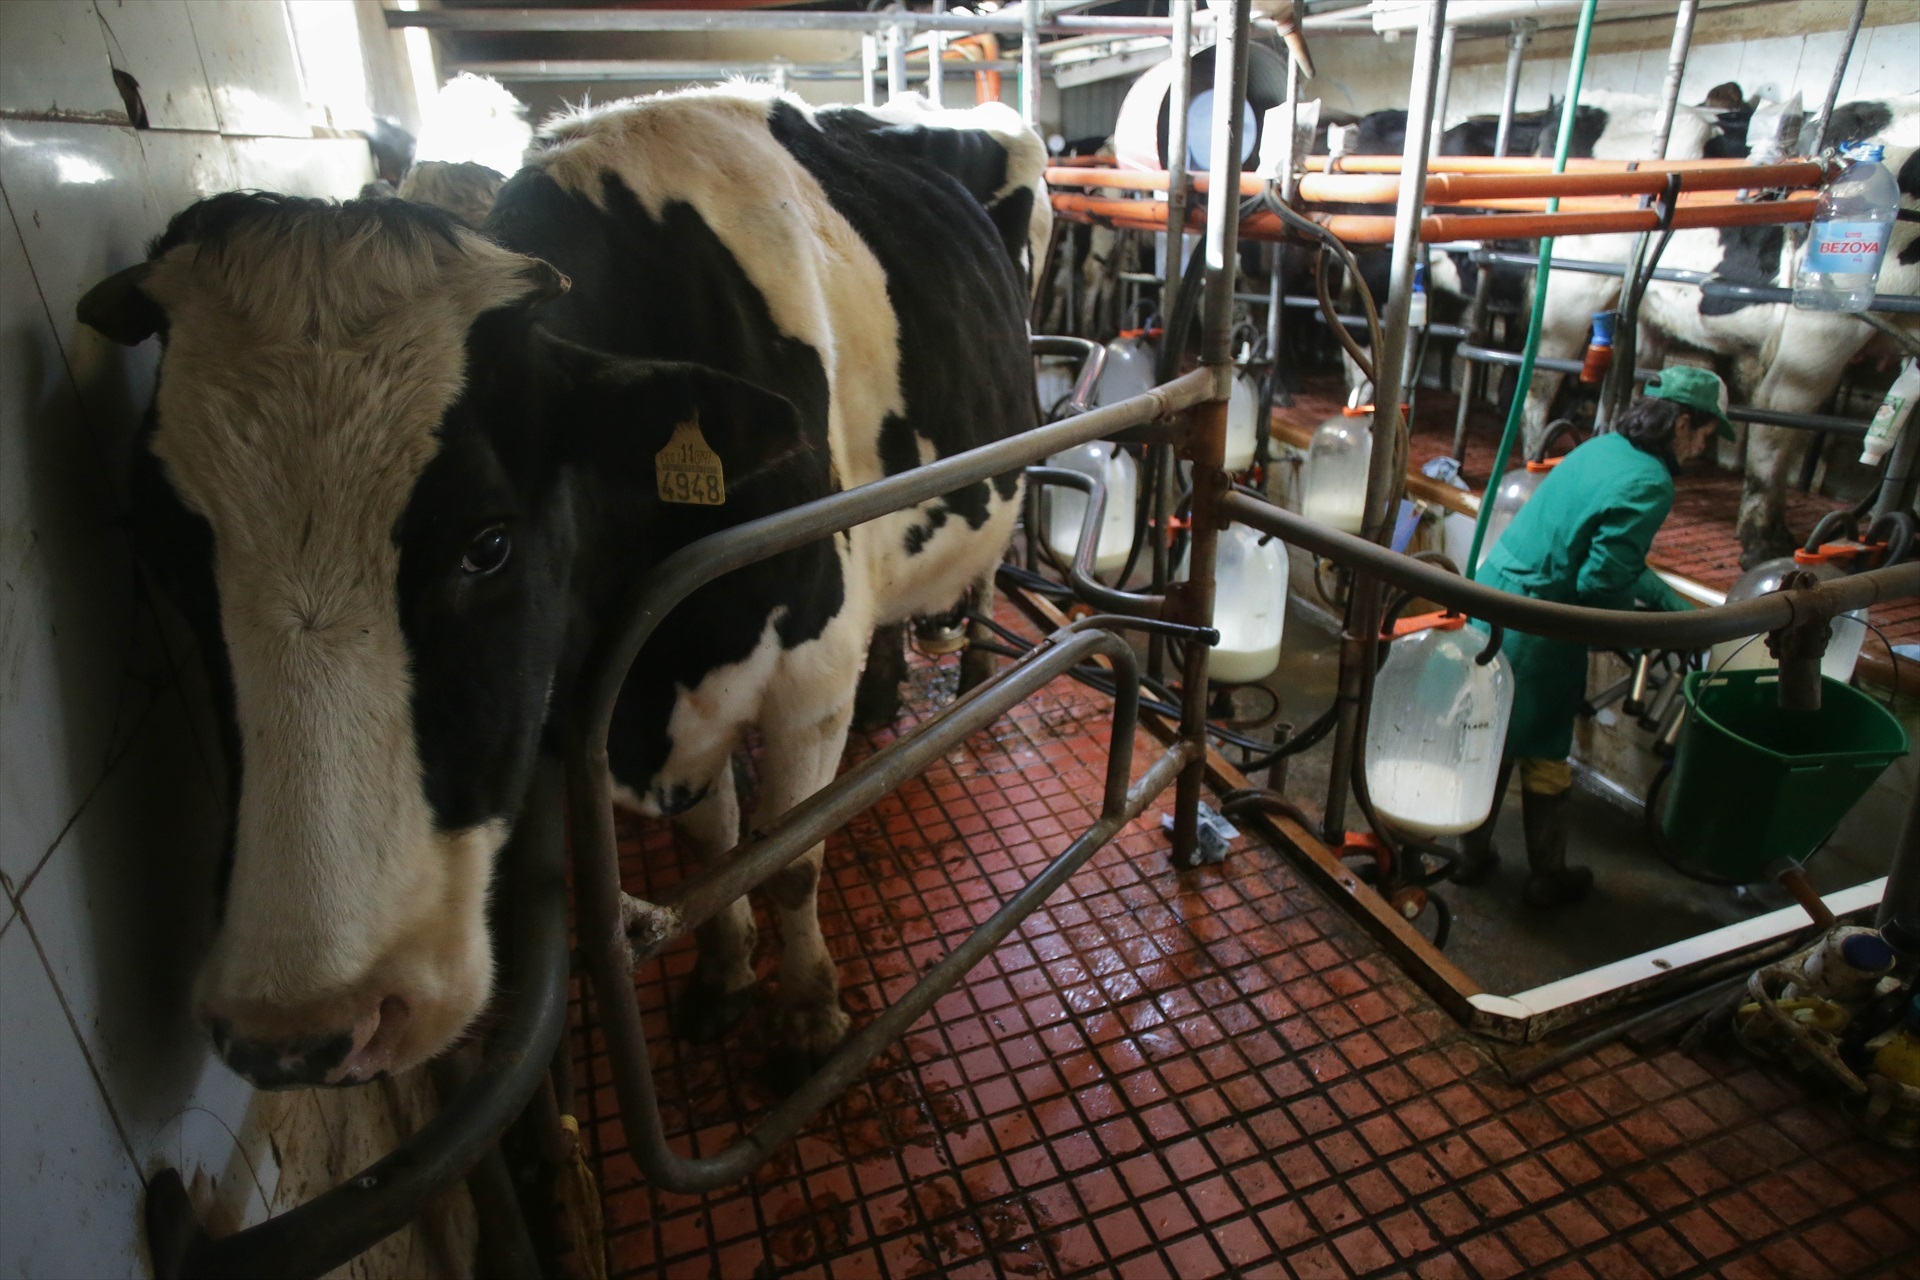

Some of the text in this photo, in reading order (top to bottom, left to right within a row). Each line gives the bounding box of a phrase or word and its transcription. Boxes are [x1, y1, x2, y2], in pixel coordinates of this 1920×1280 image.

[1819, 242, 1879, 254] BEZOYA
[681, 443, 694, 463] 11
[662, 472, 720, 502] 4948
